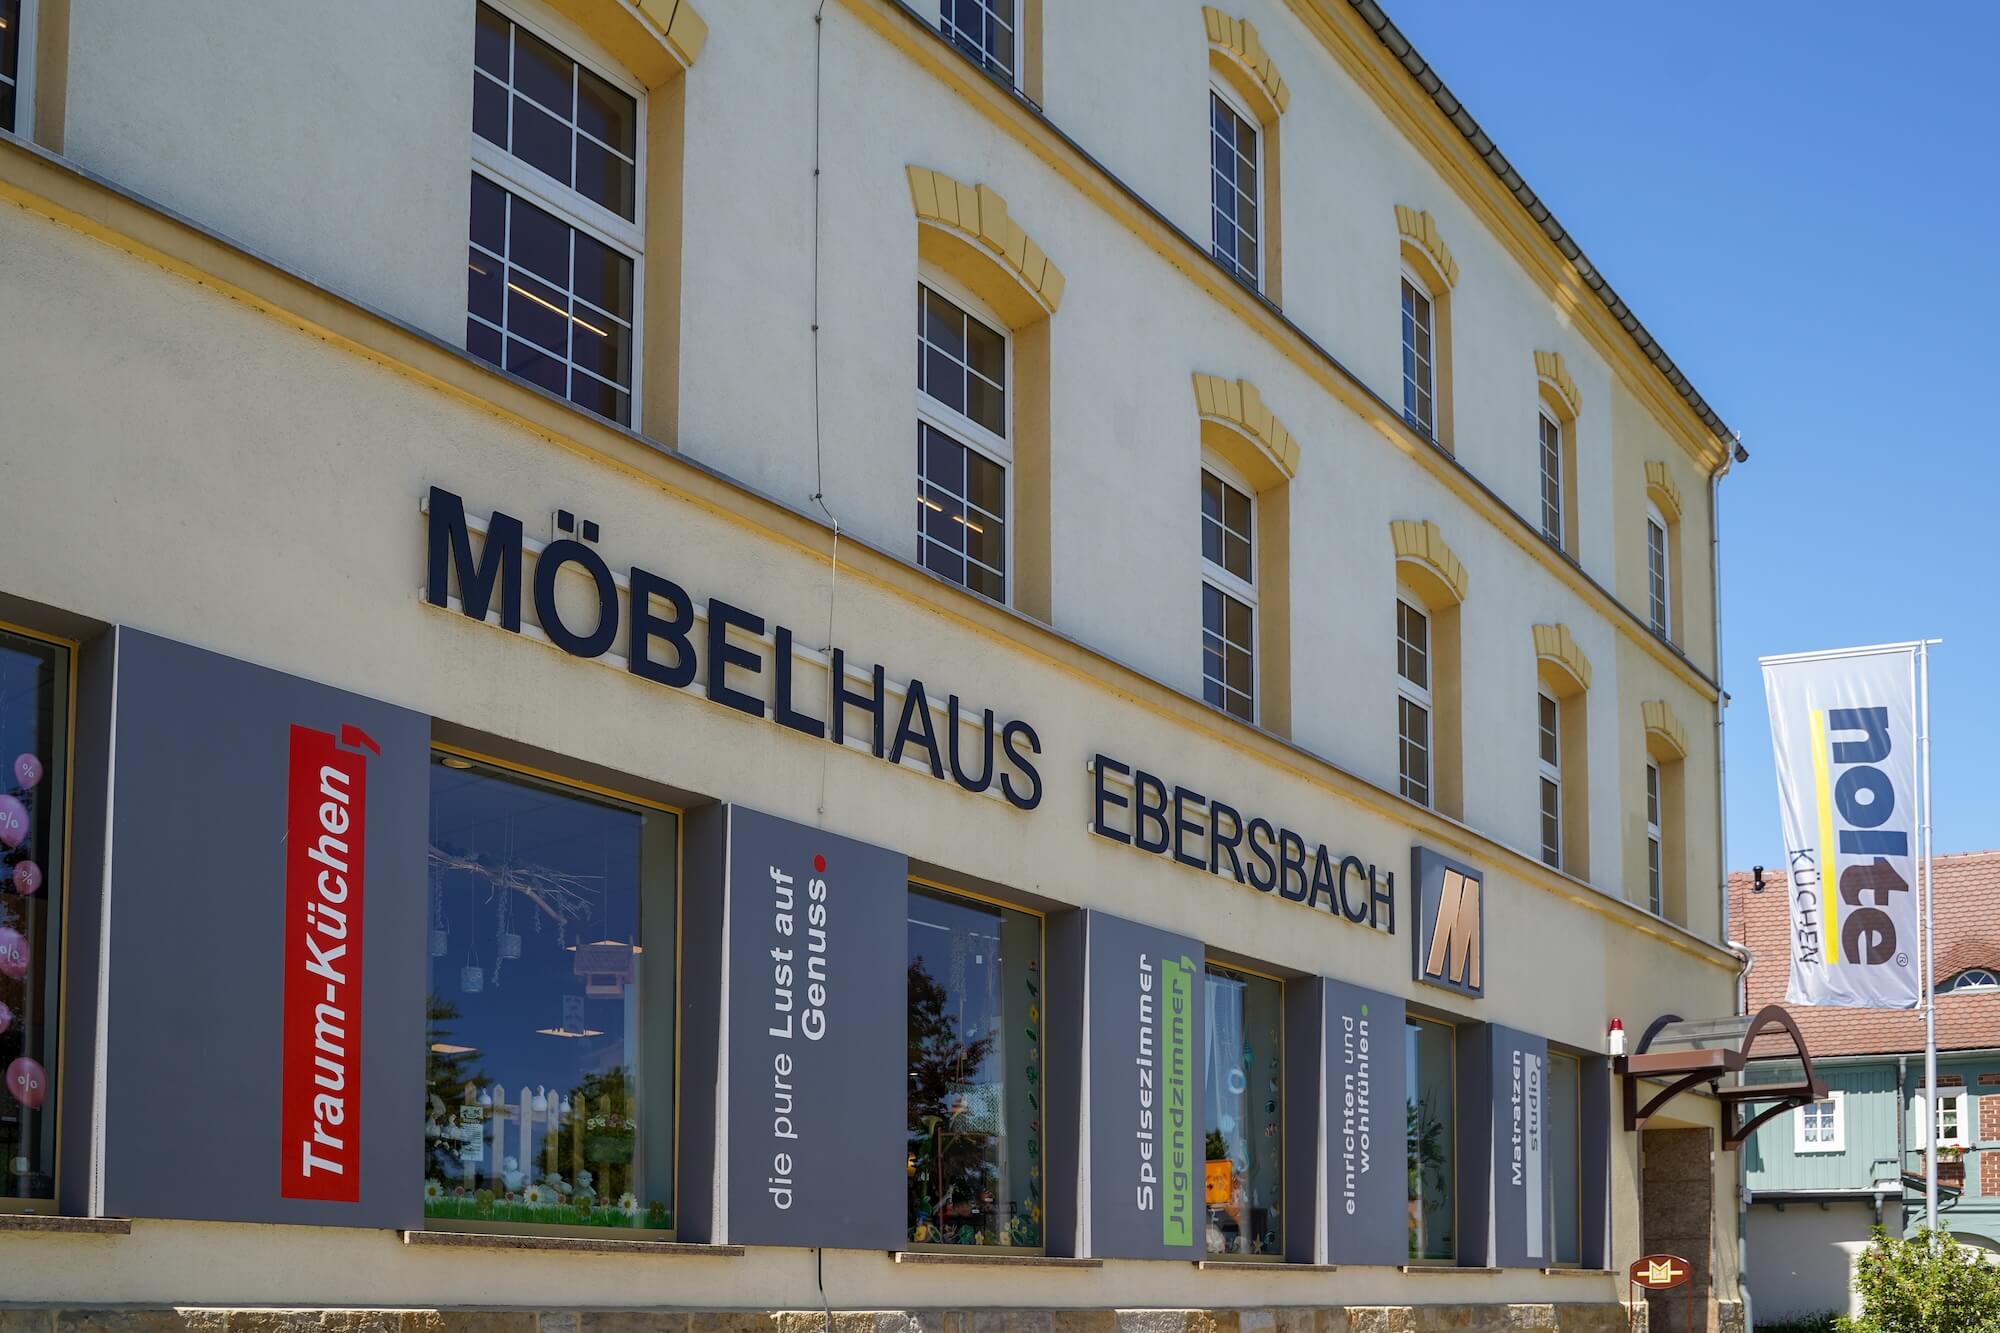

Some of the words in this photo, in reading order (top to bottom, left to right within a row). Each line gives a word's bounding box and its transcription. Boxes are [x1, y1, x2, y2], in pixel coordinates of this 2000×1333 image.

[426, 485, 1042, 810] MÖBELHAUS
[1094, 753, 1396, 935] EBERSBACH
[769, 865, 794, 937] auf
[1789, 848, 1820, 966] KÜCHEN
[769, 946, 793, 1039] Lust
[1342, 1016, 1354, 1064] und
[774, 1052, 798, 1139] pure
[1136, 953, 1157, 1212] Speisezimmer
[1511, 1050, 1522, 1186] Matratzen
[768, 1152, 793, 1210] die
[1343, 1074, 1356, 1215] einrichten
